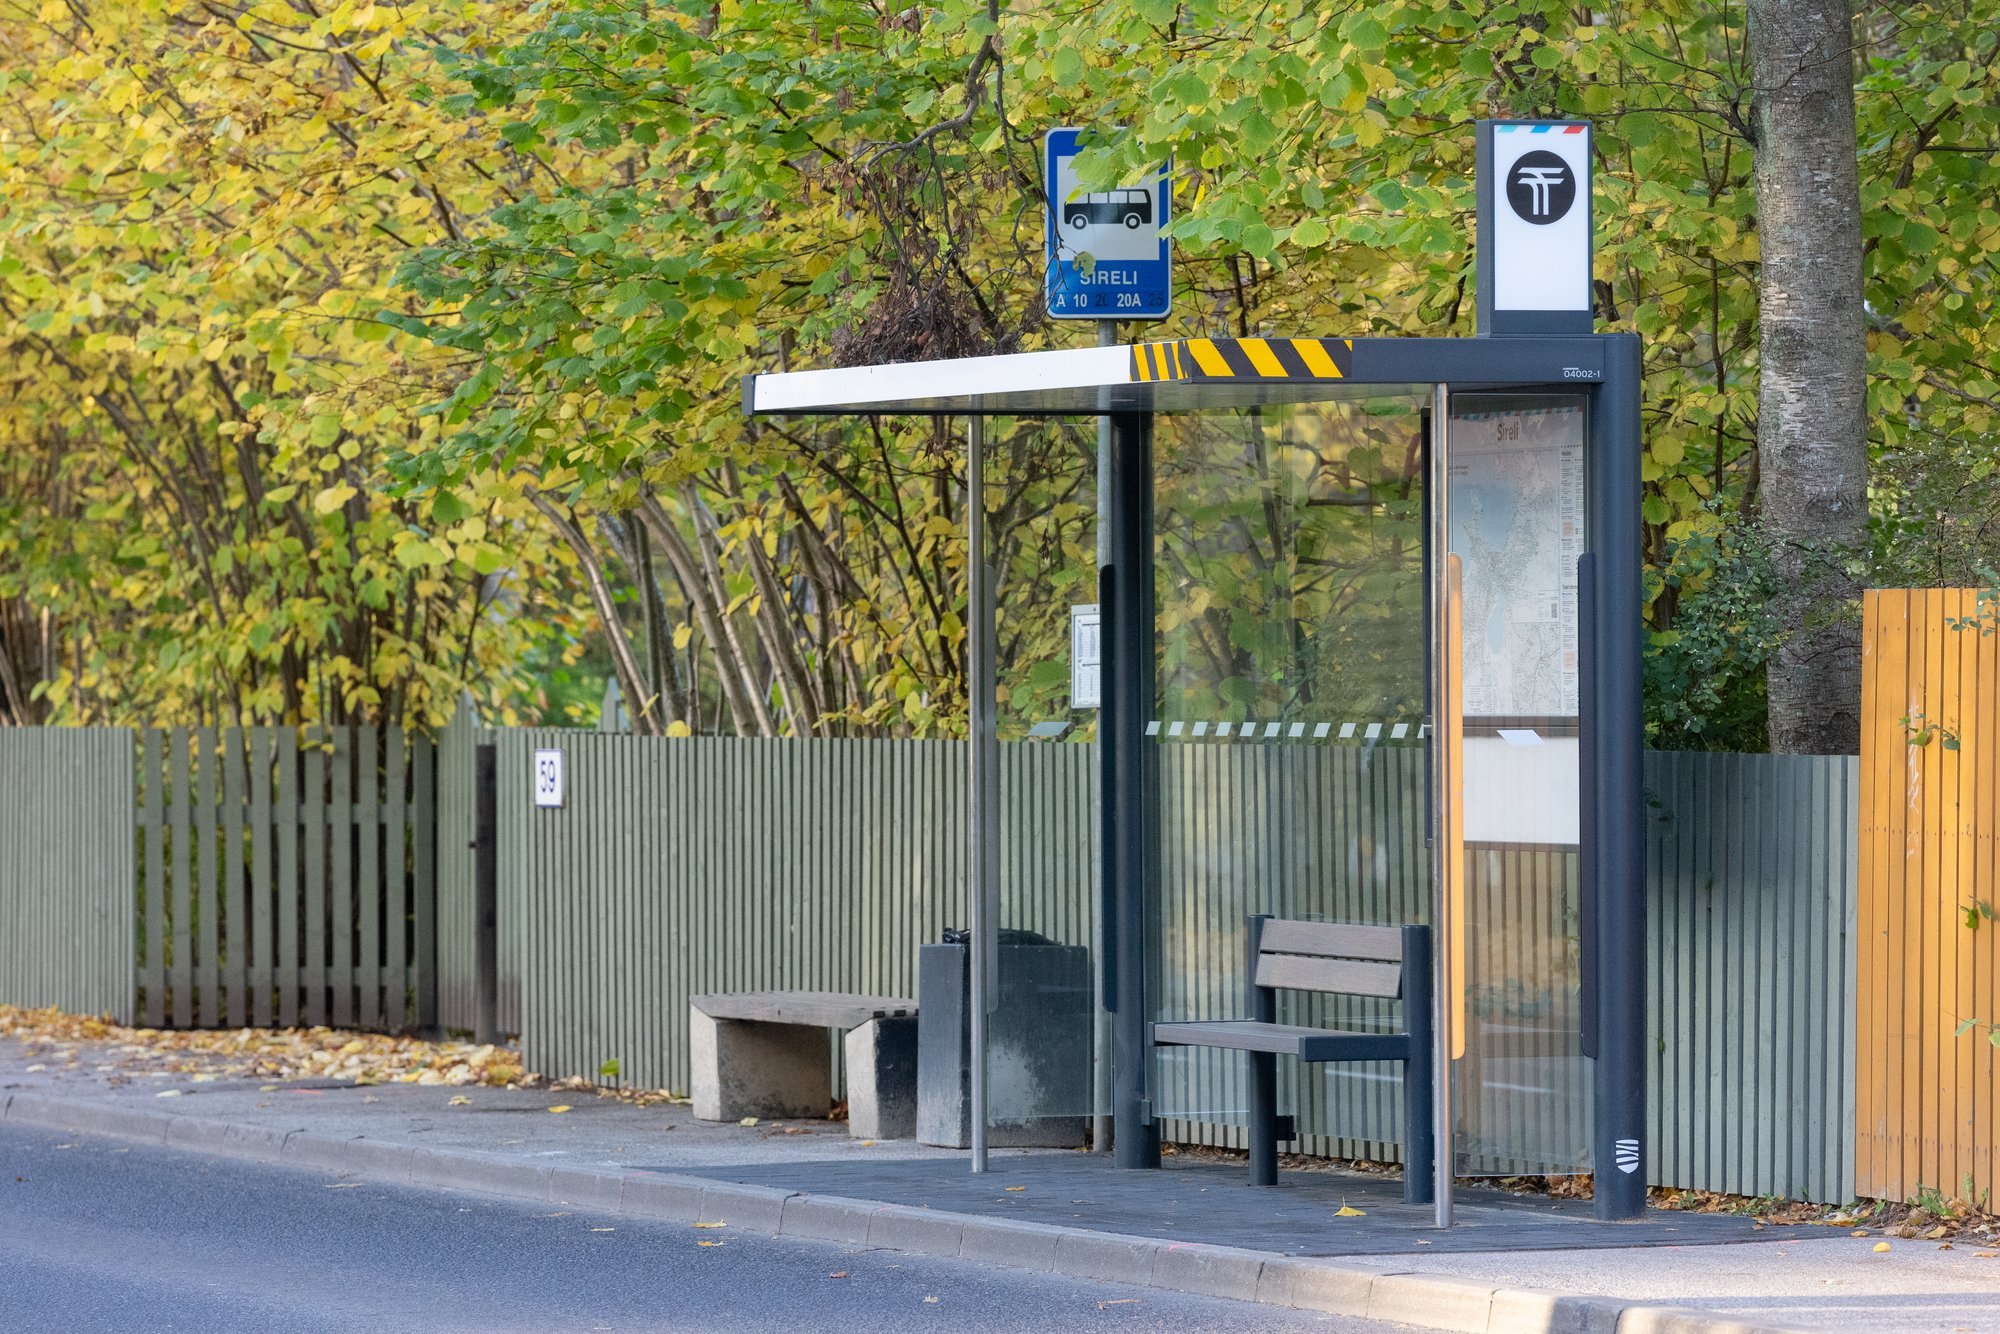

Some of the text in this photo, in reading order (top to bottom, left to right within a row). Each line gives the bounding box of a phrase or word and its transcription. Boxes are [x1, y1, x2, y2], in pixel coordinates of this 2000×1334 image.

[1080, 270, 1137, 285] SIRELI
[1056, 294, 1066, 307] A
[1073, 294, 1087, 307] 10
[1117, 294, 1141, 307] 20A
[1563, 369, 1600, 378] 04002-1
[1497, 421, 1518, 441] Sireli
[541, 760, 555, 792] 59
